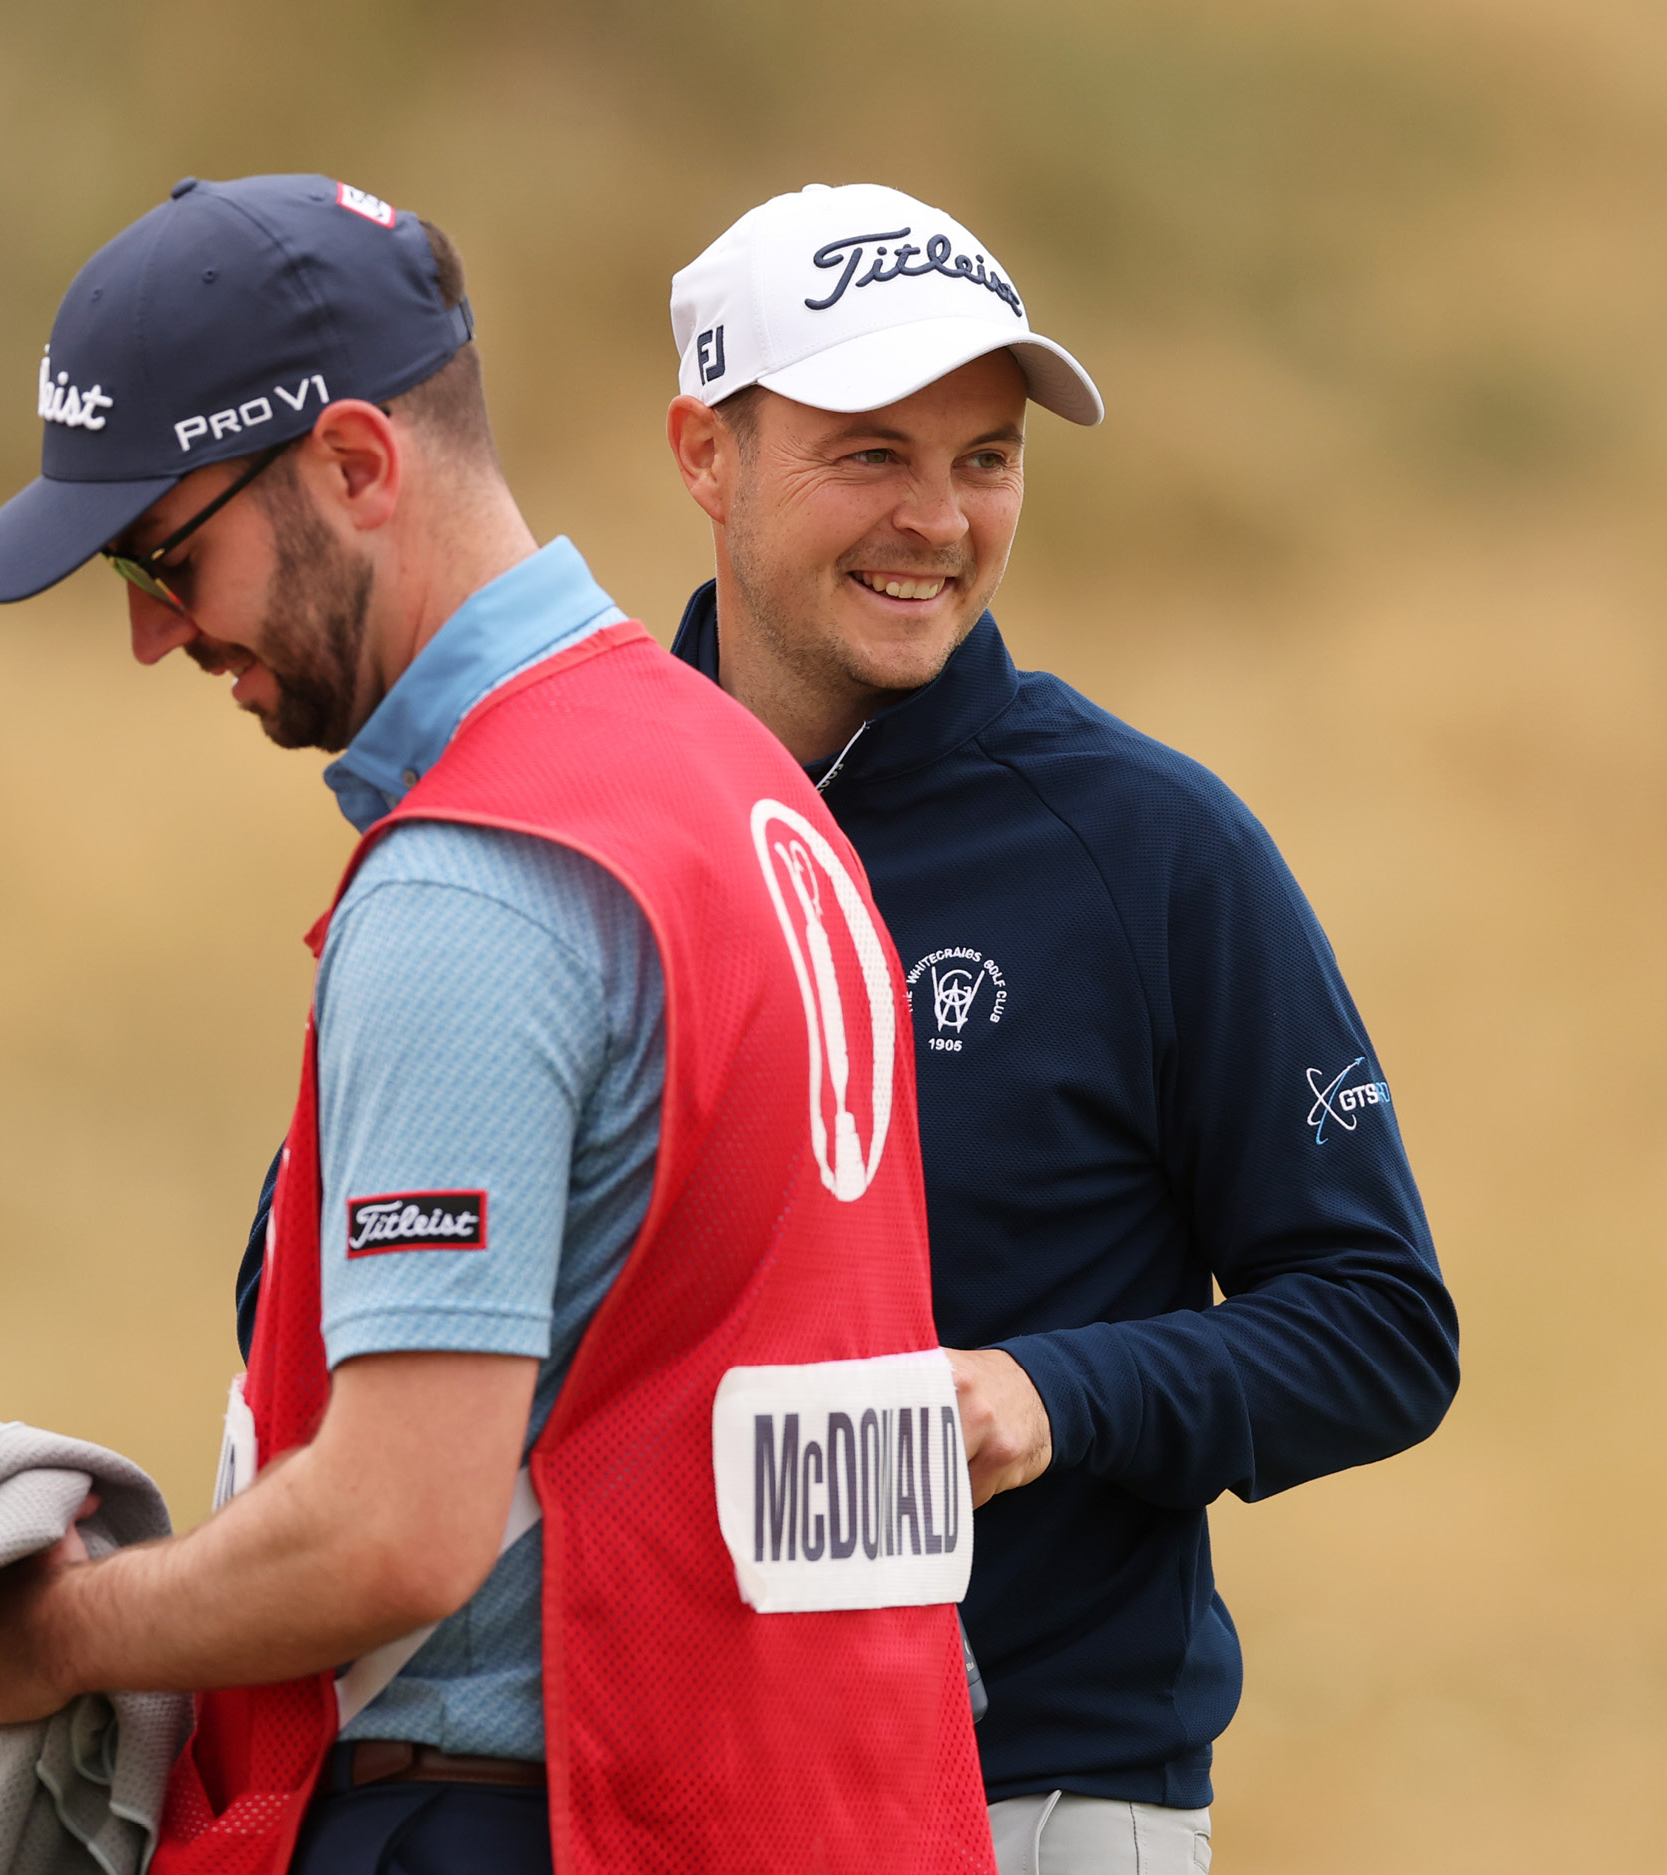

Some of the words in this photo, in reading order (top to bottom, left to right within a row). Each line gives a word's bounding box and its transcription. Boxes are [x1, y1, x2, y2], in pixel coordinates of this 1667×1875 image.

[696, 324, 725, 386] FJ
[173, 396, 274, 453] PRO
[274, 374, 329, 411] V1
[905, 946, 983, 984] WHITECRAIGS
[983, 959, 1007, 988] GOLF
[989, 990, 1008, 1024] CLUB
[348, 1199, 480, 1250] Titleist
